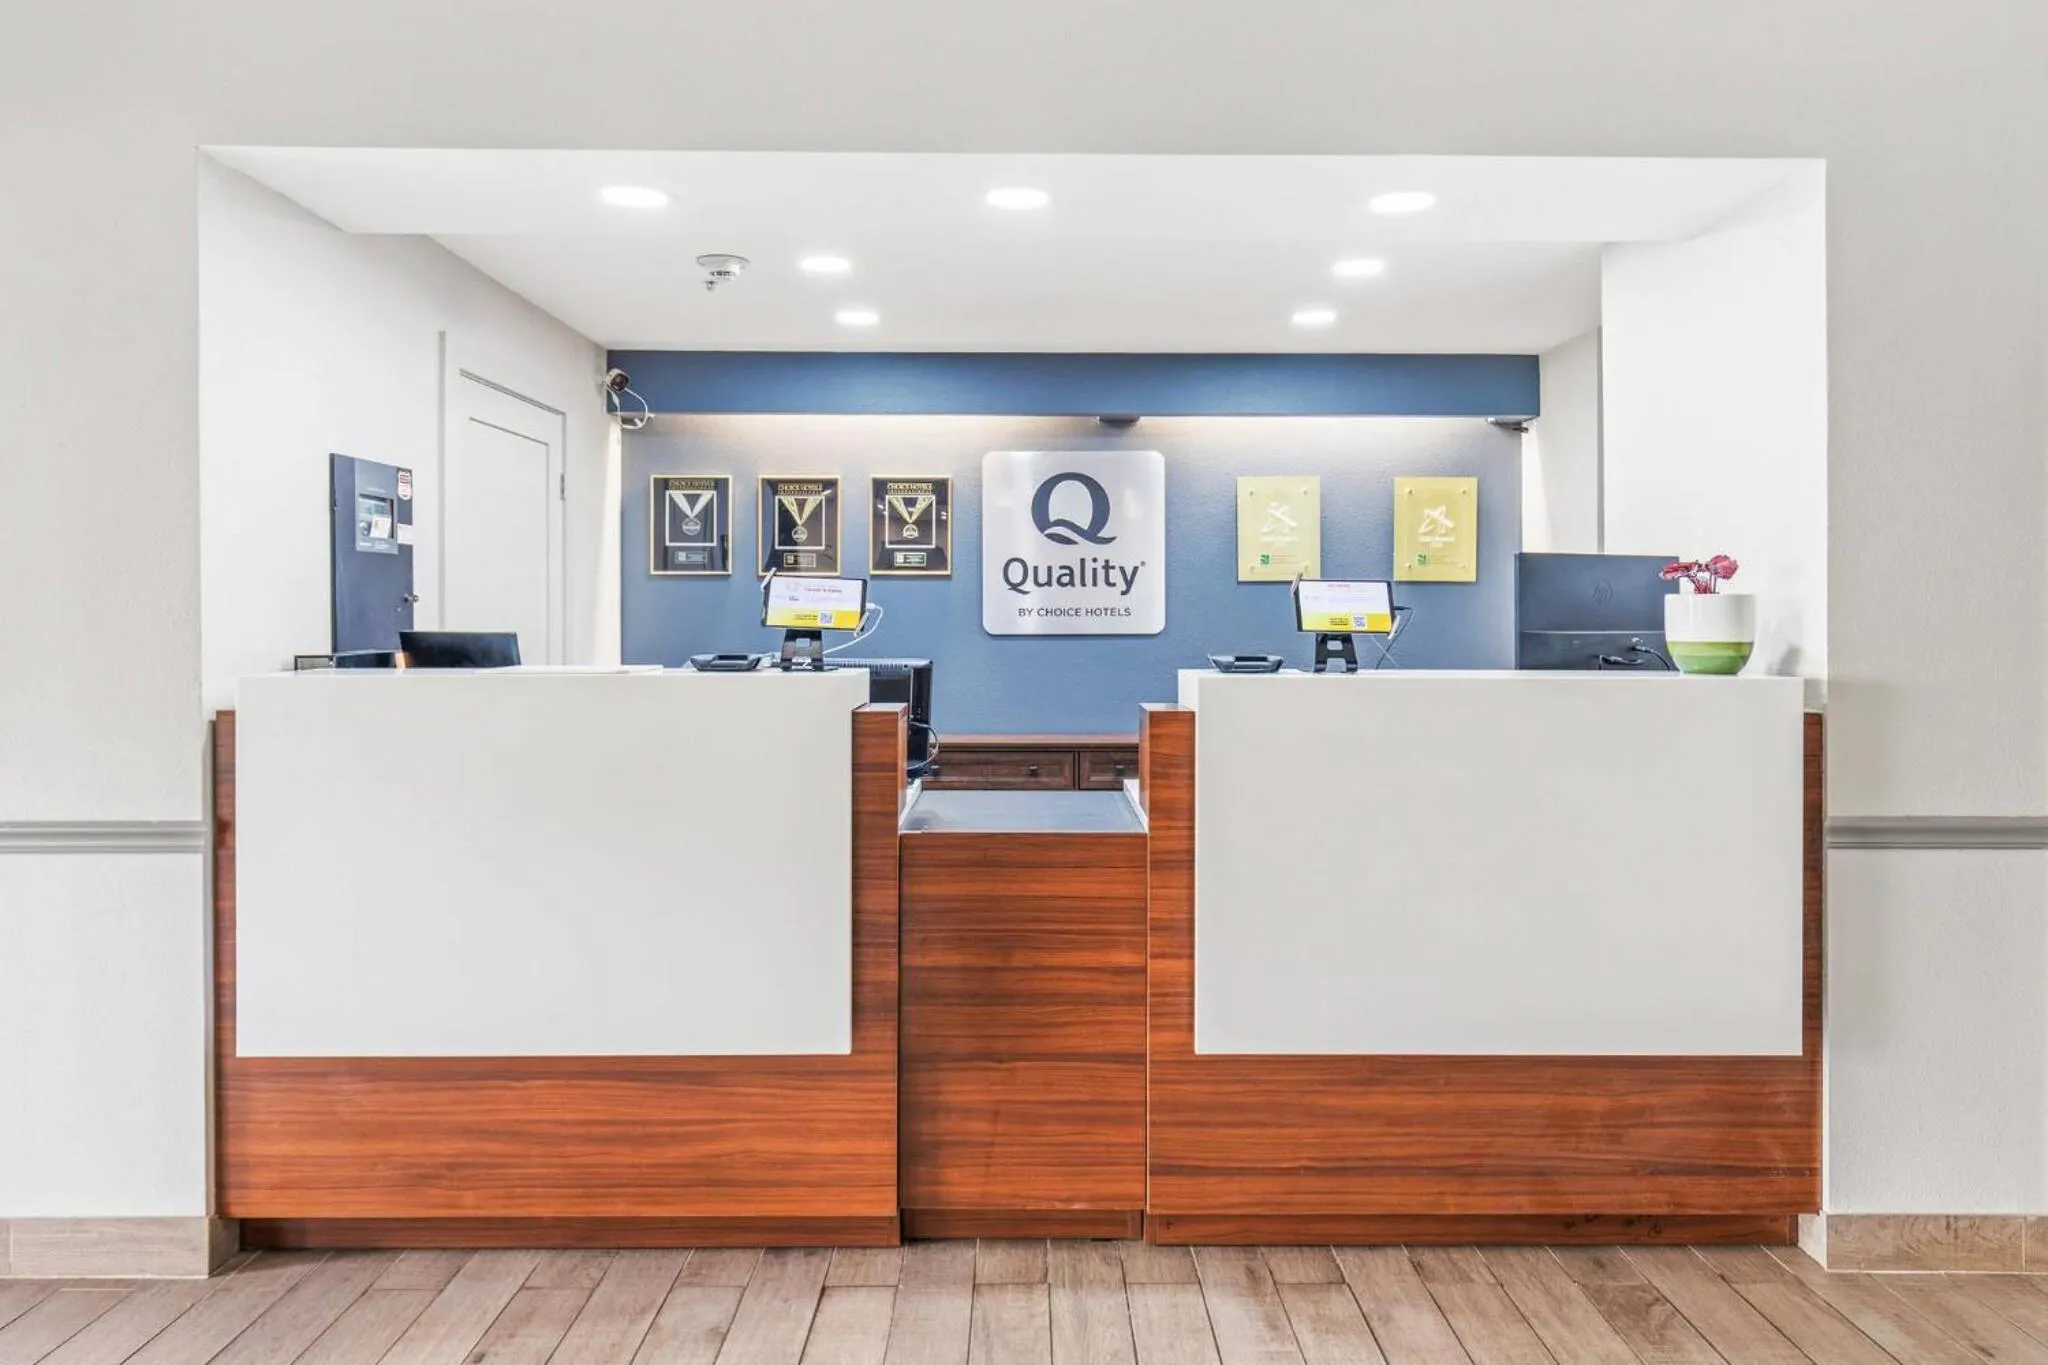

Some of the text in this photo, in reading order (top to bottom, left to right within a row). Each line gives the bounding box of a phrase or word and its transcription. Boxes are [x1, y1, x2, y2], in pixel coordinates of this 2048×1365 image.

[1031, 472, 1118, 546] Q
[1003, 557, 1140, 596] Quality
[1018, 607, 1132, 618] BY CHOICE HOTELS
